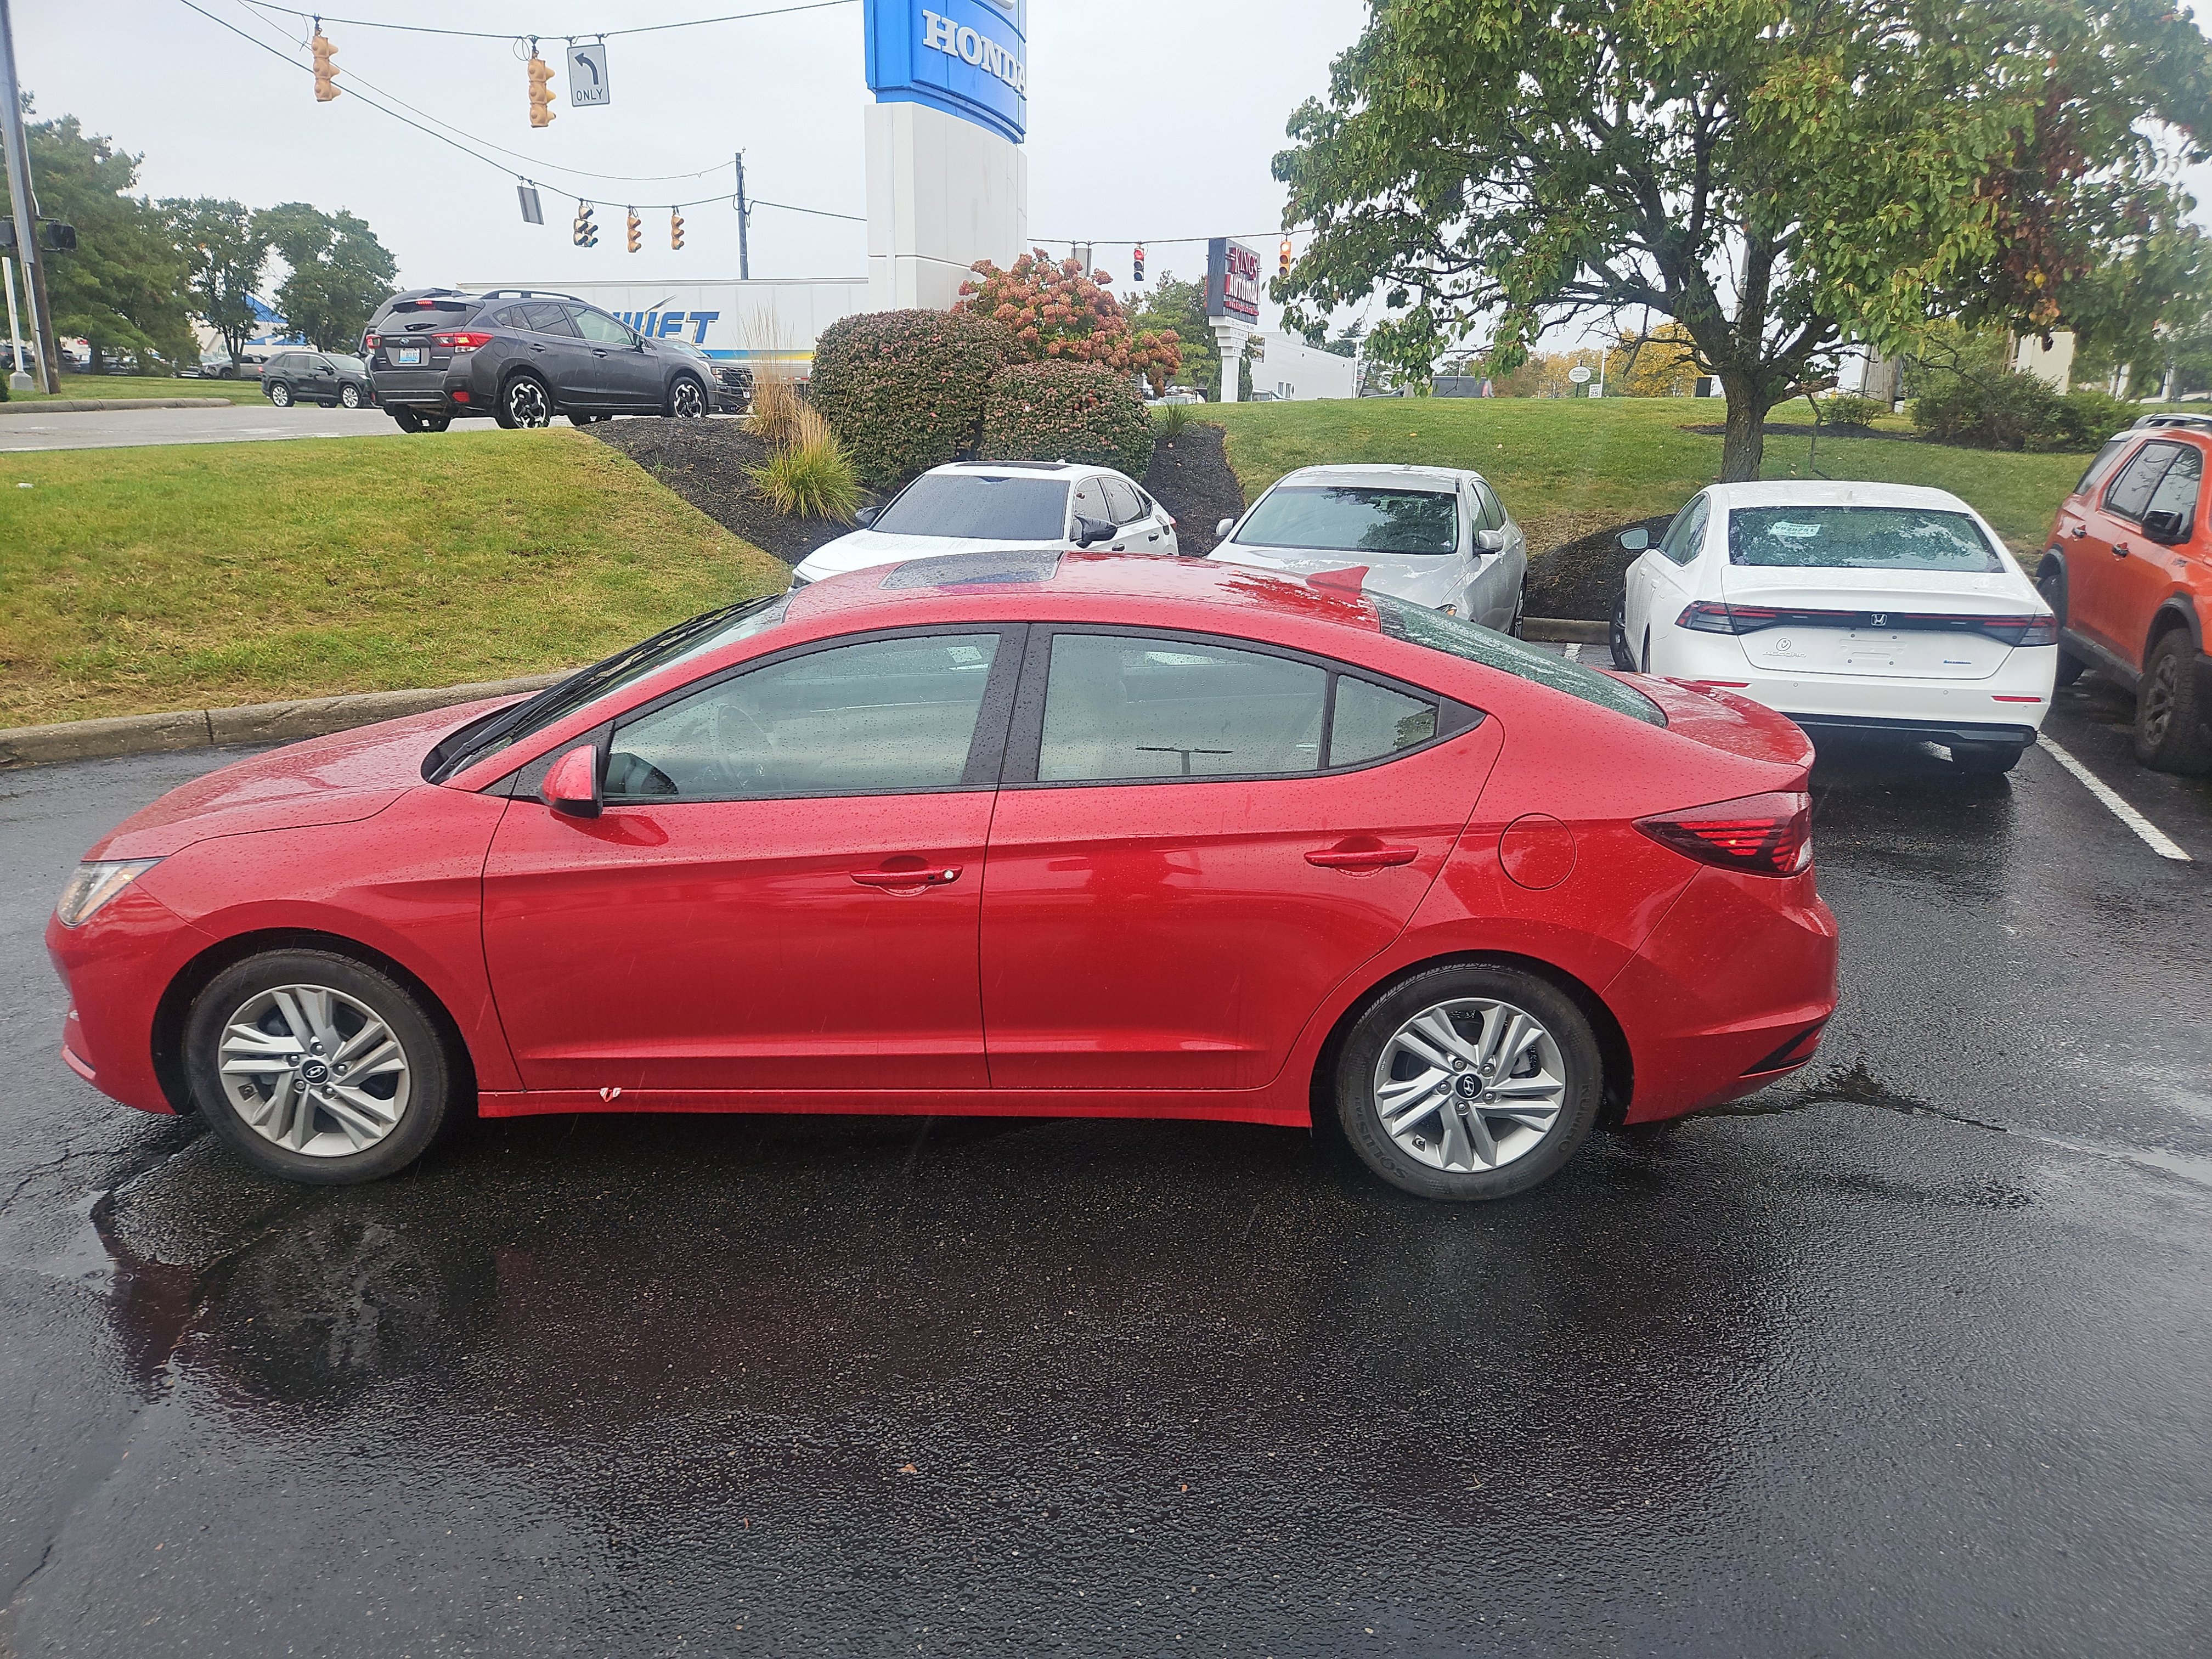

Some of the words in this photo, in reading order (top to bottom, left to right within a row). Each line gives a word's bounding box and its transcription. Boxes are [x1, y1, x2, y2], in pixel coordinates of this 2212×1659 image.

[922, 9, 1027, 101] HONDA
[576, 88, 603, 101] ONLY
[1234, 247, 1258, 281] KINGS
[1229, 274, 1261, 306] AUTOMALL
